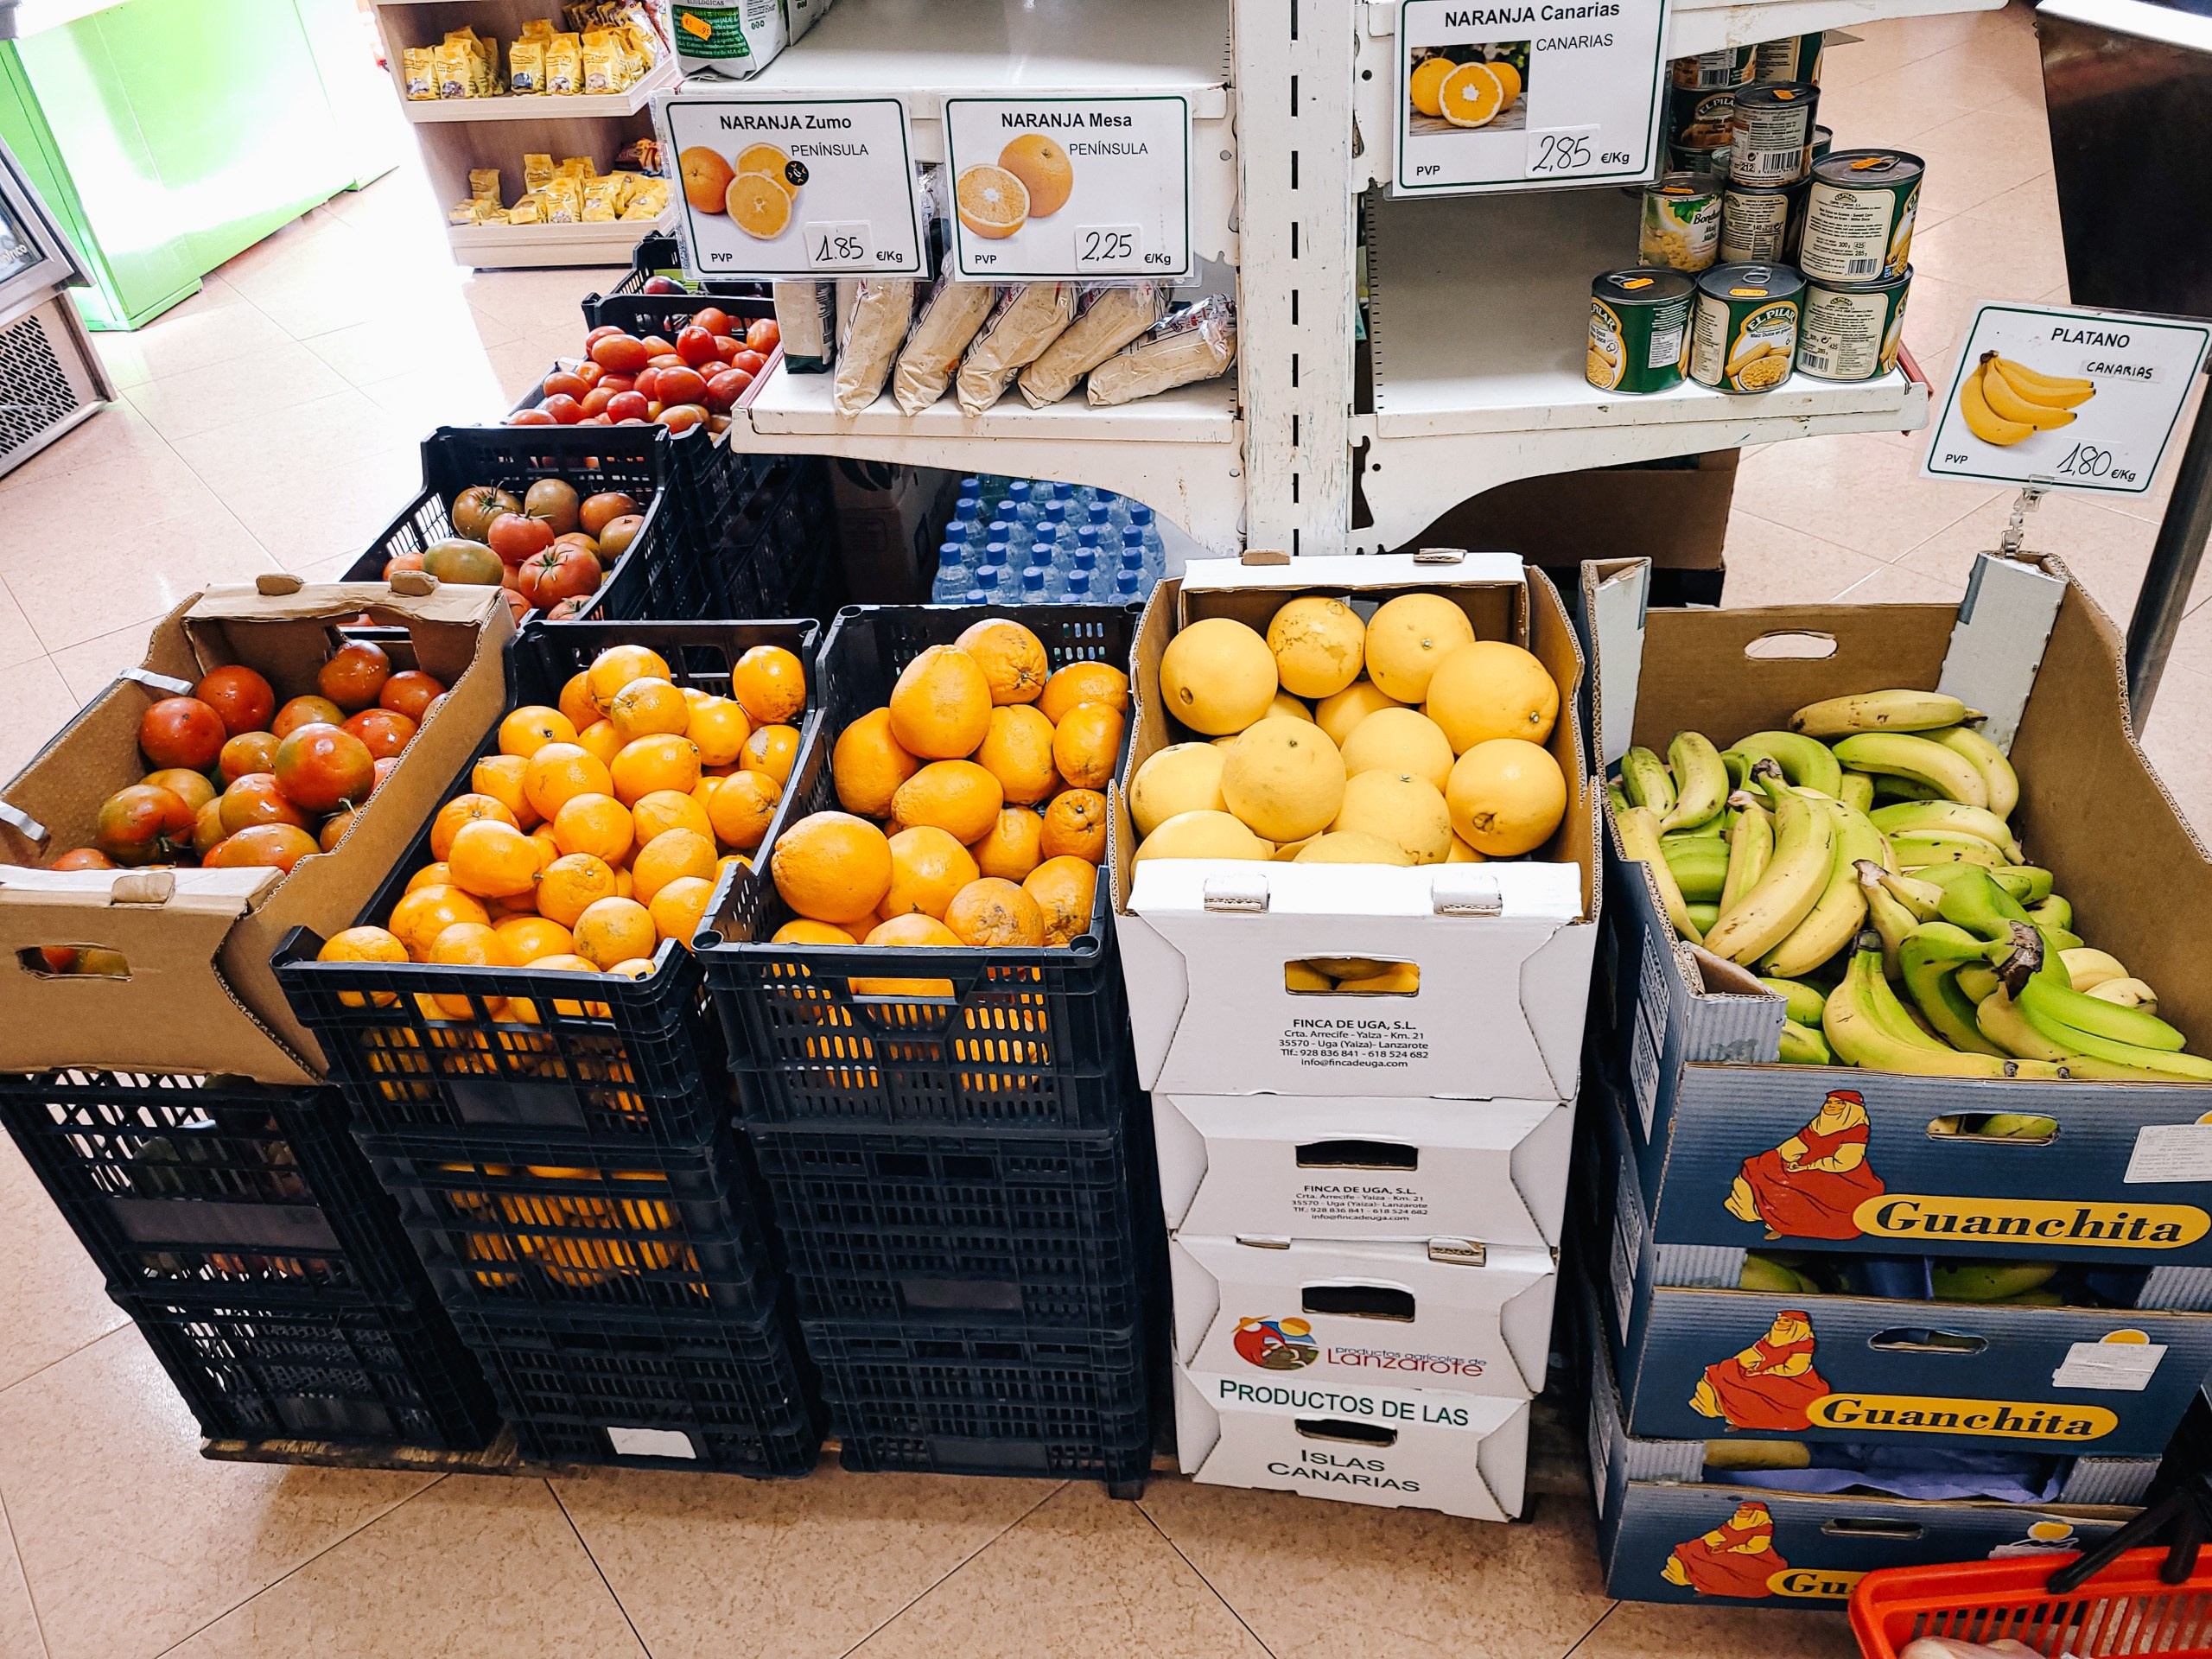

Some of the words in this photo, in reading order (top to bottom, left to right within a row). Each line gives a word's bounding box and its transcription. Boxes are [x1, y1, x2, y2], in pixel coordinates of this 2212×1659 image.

[1445, 7, 1535, 27] NARANJA
[1541, 3, 1620, 21] Canarias
[1535, 33, 1614, 52] CANARIAS
[720, 115, 803, 130] NARANJA
[804, 115, 852, 130] Zumo
[1001, 113, 1084, 128] NARANJA
[1090, 112, 1132, 127] Mesa
[791, 142, 869, 156] PENÍNSULA
[1069, 140, 1148, 156] PENÍNSULA
[1600, 152, 1630, 165] €/Kg
[1416, 165, 1440, 176] PVP
[711, 252, 733, 263] PVP
[876, 251, 903, 263] €/Kg
[975, 254, 997, 264] PVP
[1144, 253, 1172, 266] €/Kg
[1747, 316, 1767, 330] EL
[1765, 308, 1796, 323] PILAR
[2051, 327, 2130, 347] PLATANO
[2086, 361, 2154, 379] CANARIAS
[1945, 454, 1968, 465] PVP
[2111, 469, 2136, 482] €/Kg
[1293, 1019, 1332, 1028] FINCA
[1336, 1020, 1354, 1028] DE
[1357, 1020, 1390, 1030] UGA,
[1393, 1020, 1417, 1030] S.L.
[1318, 1040, 1338, 1049] Uga
[1301, 1058, 1408, 1068] info@fincadeuga.com
[1875, 1200, 2182, 1243] Guanchita
[1327, 1348, 1484, 1376] Lanzarote
[1335, 1346, 1401, 1358] productos
[1404, 1351, 1465, 1365] agrícolas
[1468, 1357, 1487, 1366] de
[1219, 1379, 1374, 1415] PRODUCTOS
[1382, 1400, 1415, 1421] DE
[1422, 1404, 1469, 1426] LAS
[1822, 1398, 2094, 1437] Guanchita
[1301, 1449, 1385, 1471] ISLAS
[1267, 1462, 1421, 1492] CANARIAS
